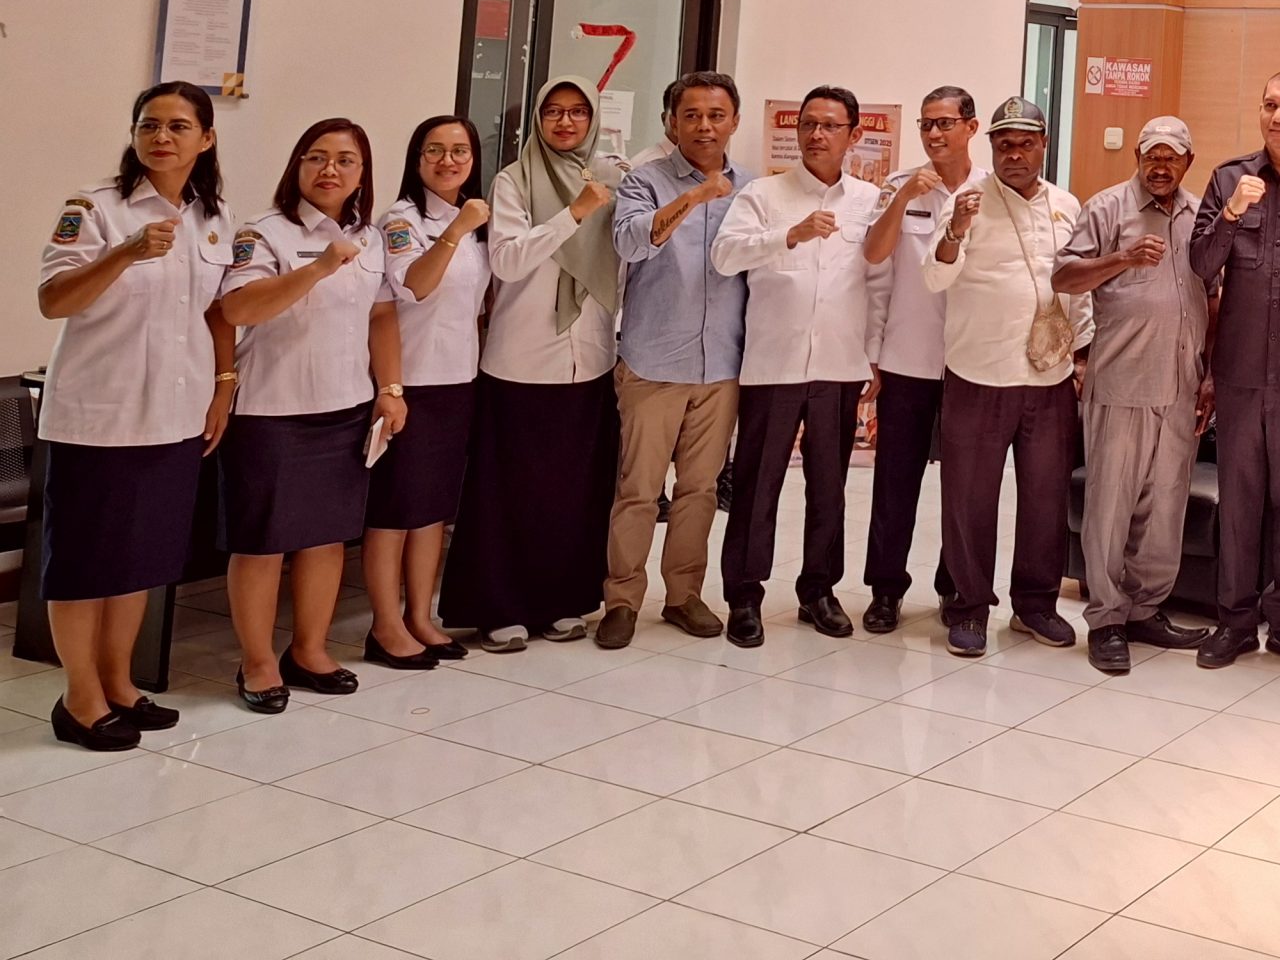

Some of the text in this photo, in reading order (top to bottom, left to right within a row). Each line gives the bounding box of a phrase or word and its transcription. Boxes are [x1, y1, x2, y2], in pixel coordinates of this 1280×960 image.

[1105, 62, 1151, 73] KAWASAN
[1105, 71, 1150, 82] TANPA ROKOK
